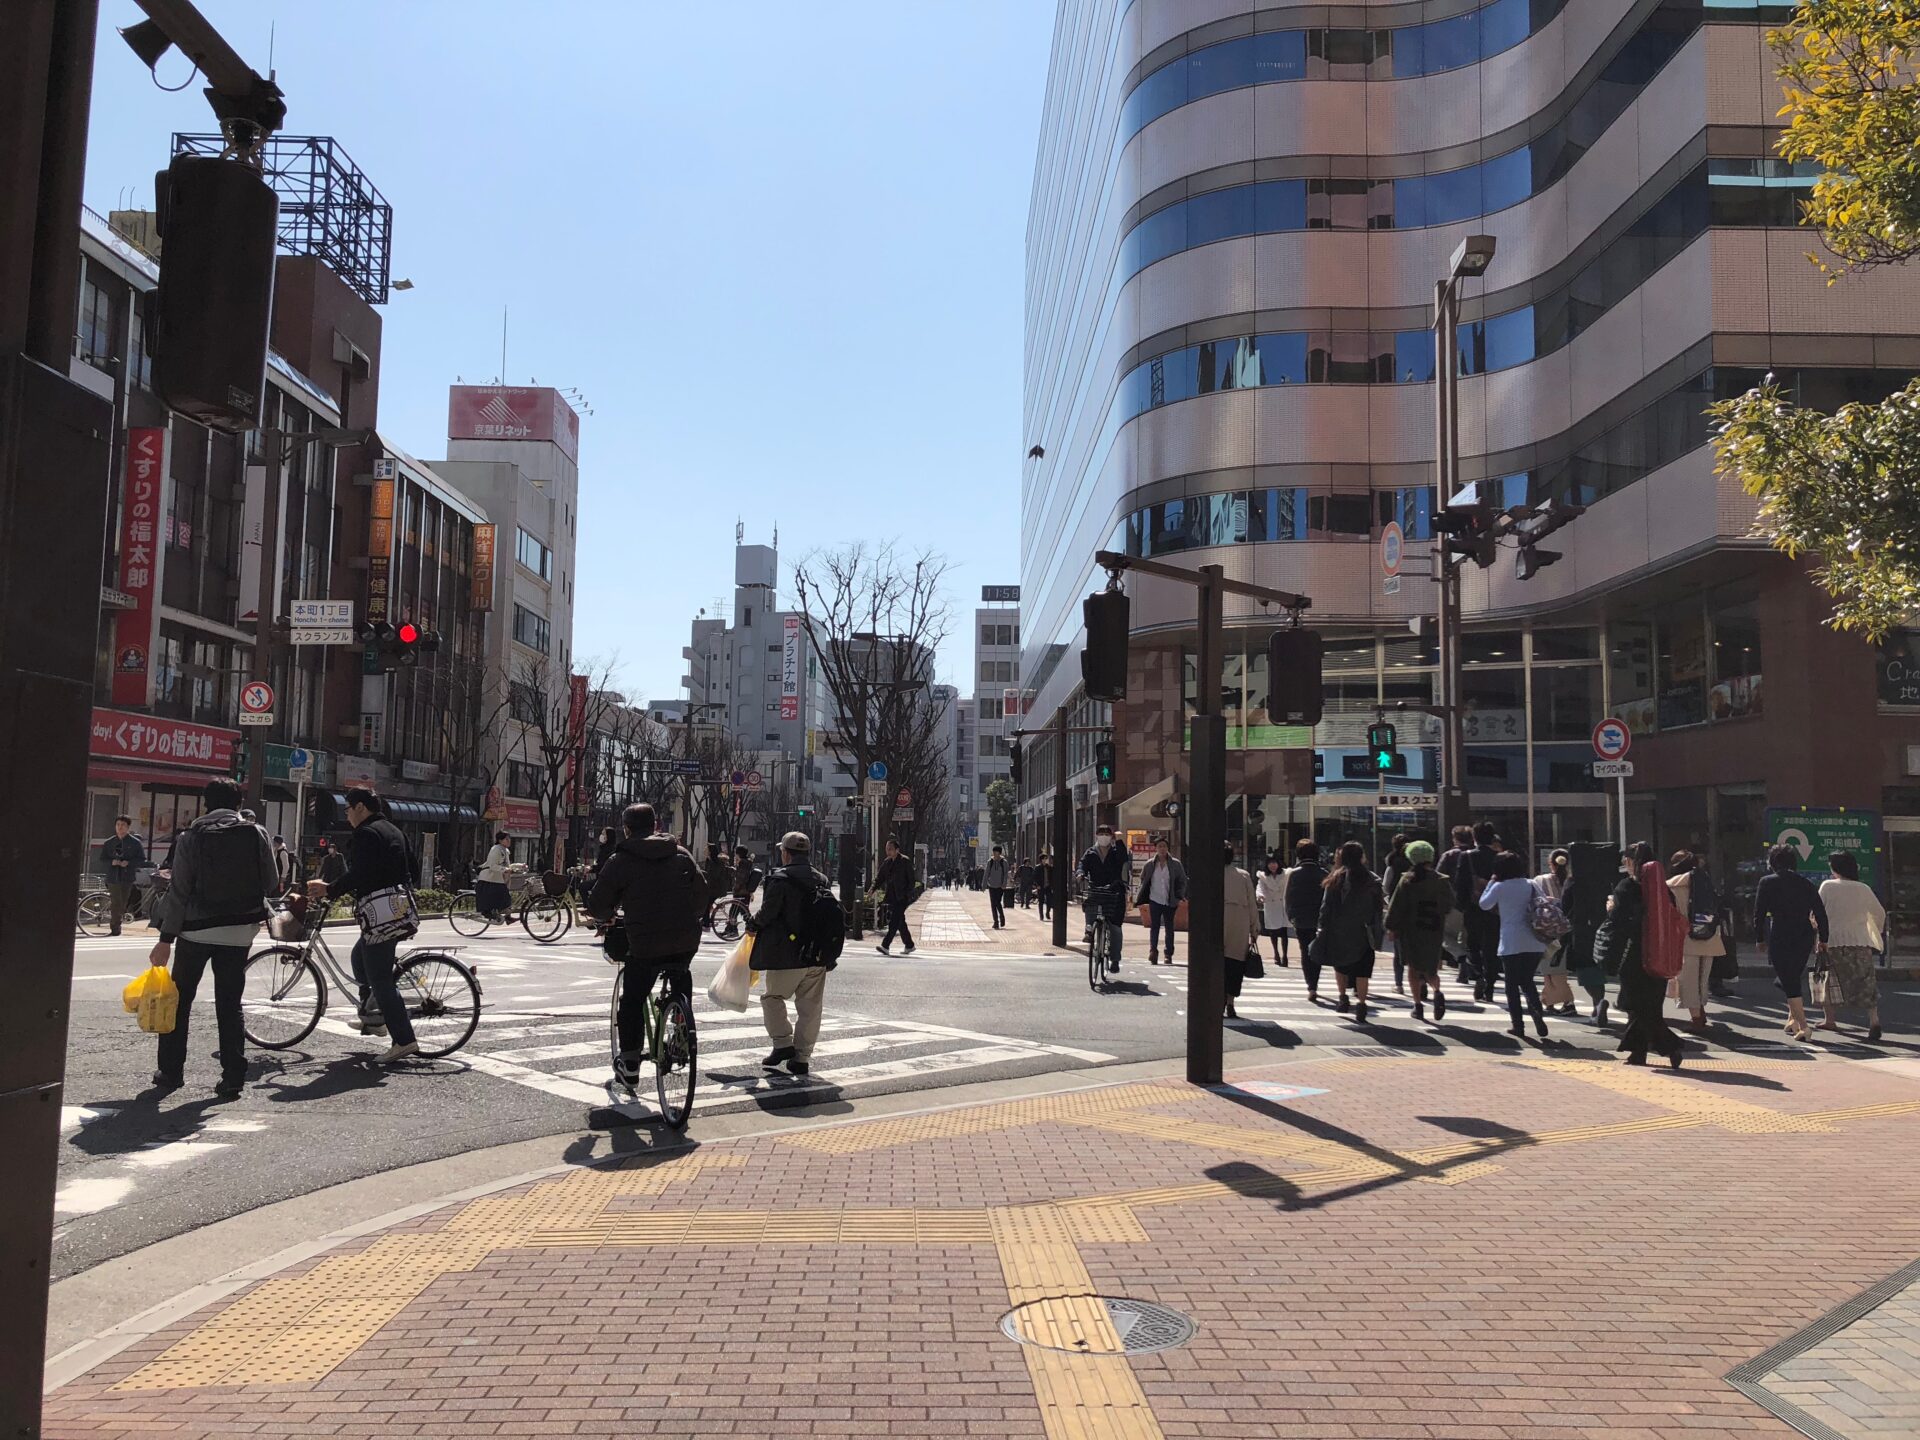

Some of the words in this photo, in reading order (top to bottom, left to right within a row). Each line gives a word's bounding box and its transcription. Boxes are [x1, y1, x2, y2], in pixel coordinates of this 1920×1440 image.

[474, 424, 532, 437] 京葉リネット
[126, 435, 156, 588] くすりの福太郎
[475, 527, 492, 609] 麻雀スクール
[987, 588, 1019, 599] 11:58
[294, 604, 349, 616] 本町1丁目
[294, 632, 349, 642] スクランブル
[784, 632, 798, 693] プラチナ館
[240, 714, 271, 723] ここから
[781, 707, 797, 718] 2F
[115, 720, 213, 760] くすりの福太郎
